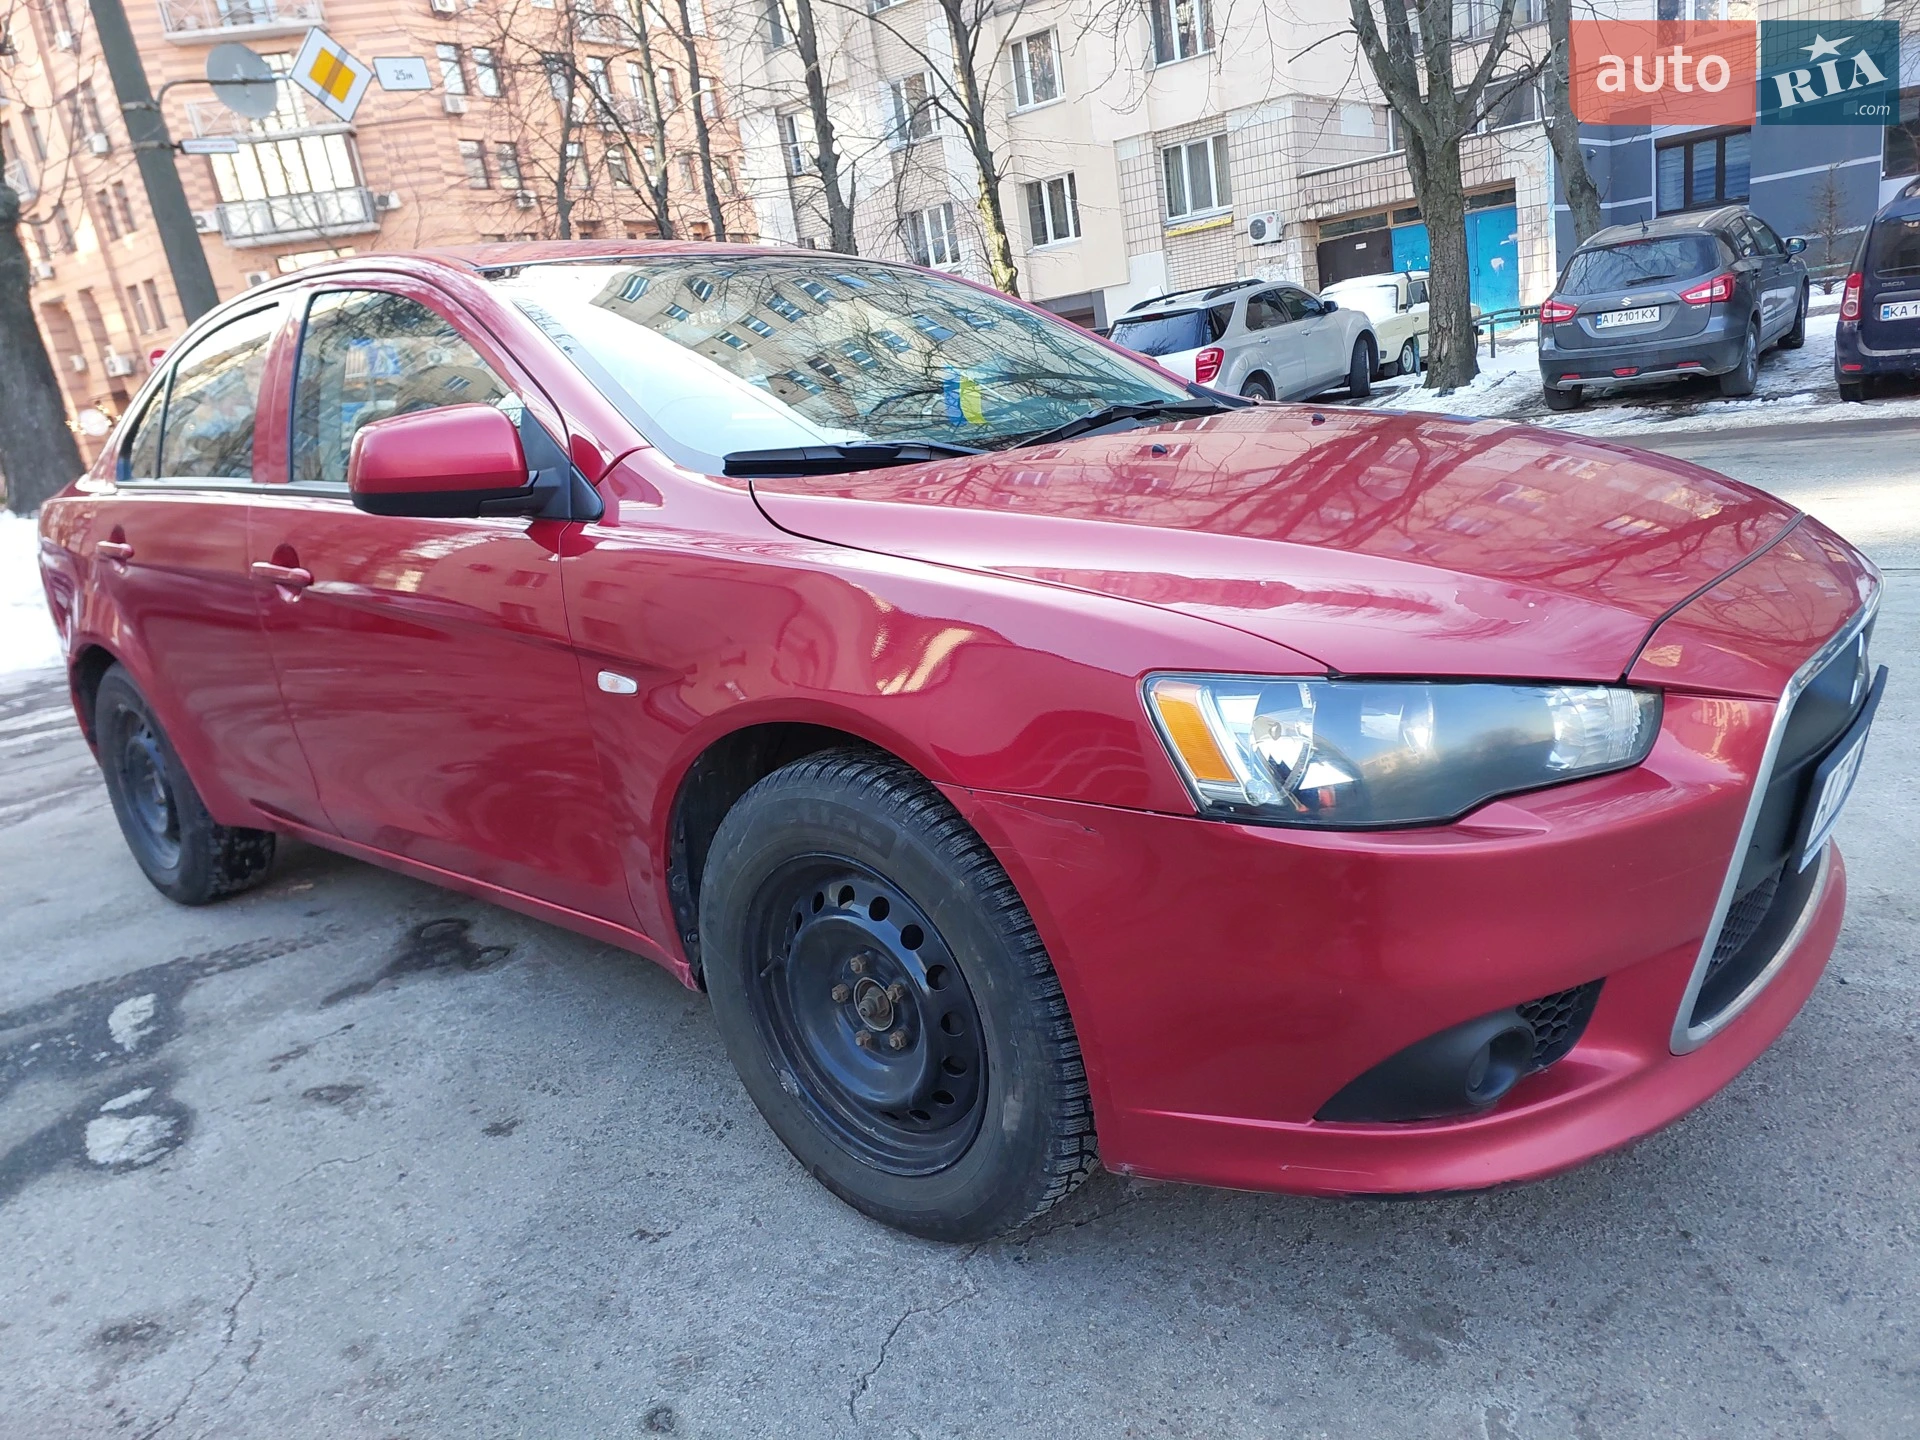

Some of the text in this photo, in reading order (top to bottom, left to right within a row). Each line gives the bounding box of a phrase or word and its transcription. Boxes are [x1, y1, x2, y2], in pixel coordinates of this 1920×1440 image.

[1602, 308, 1657, 324] AI 2101 KX
[1890, 305, 1908, 318] KA
